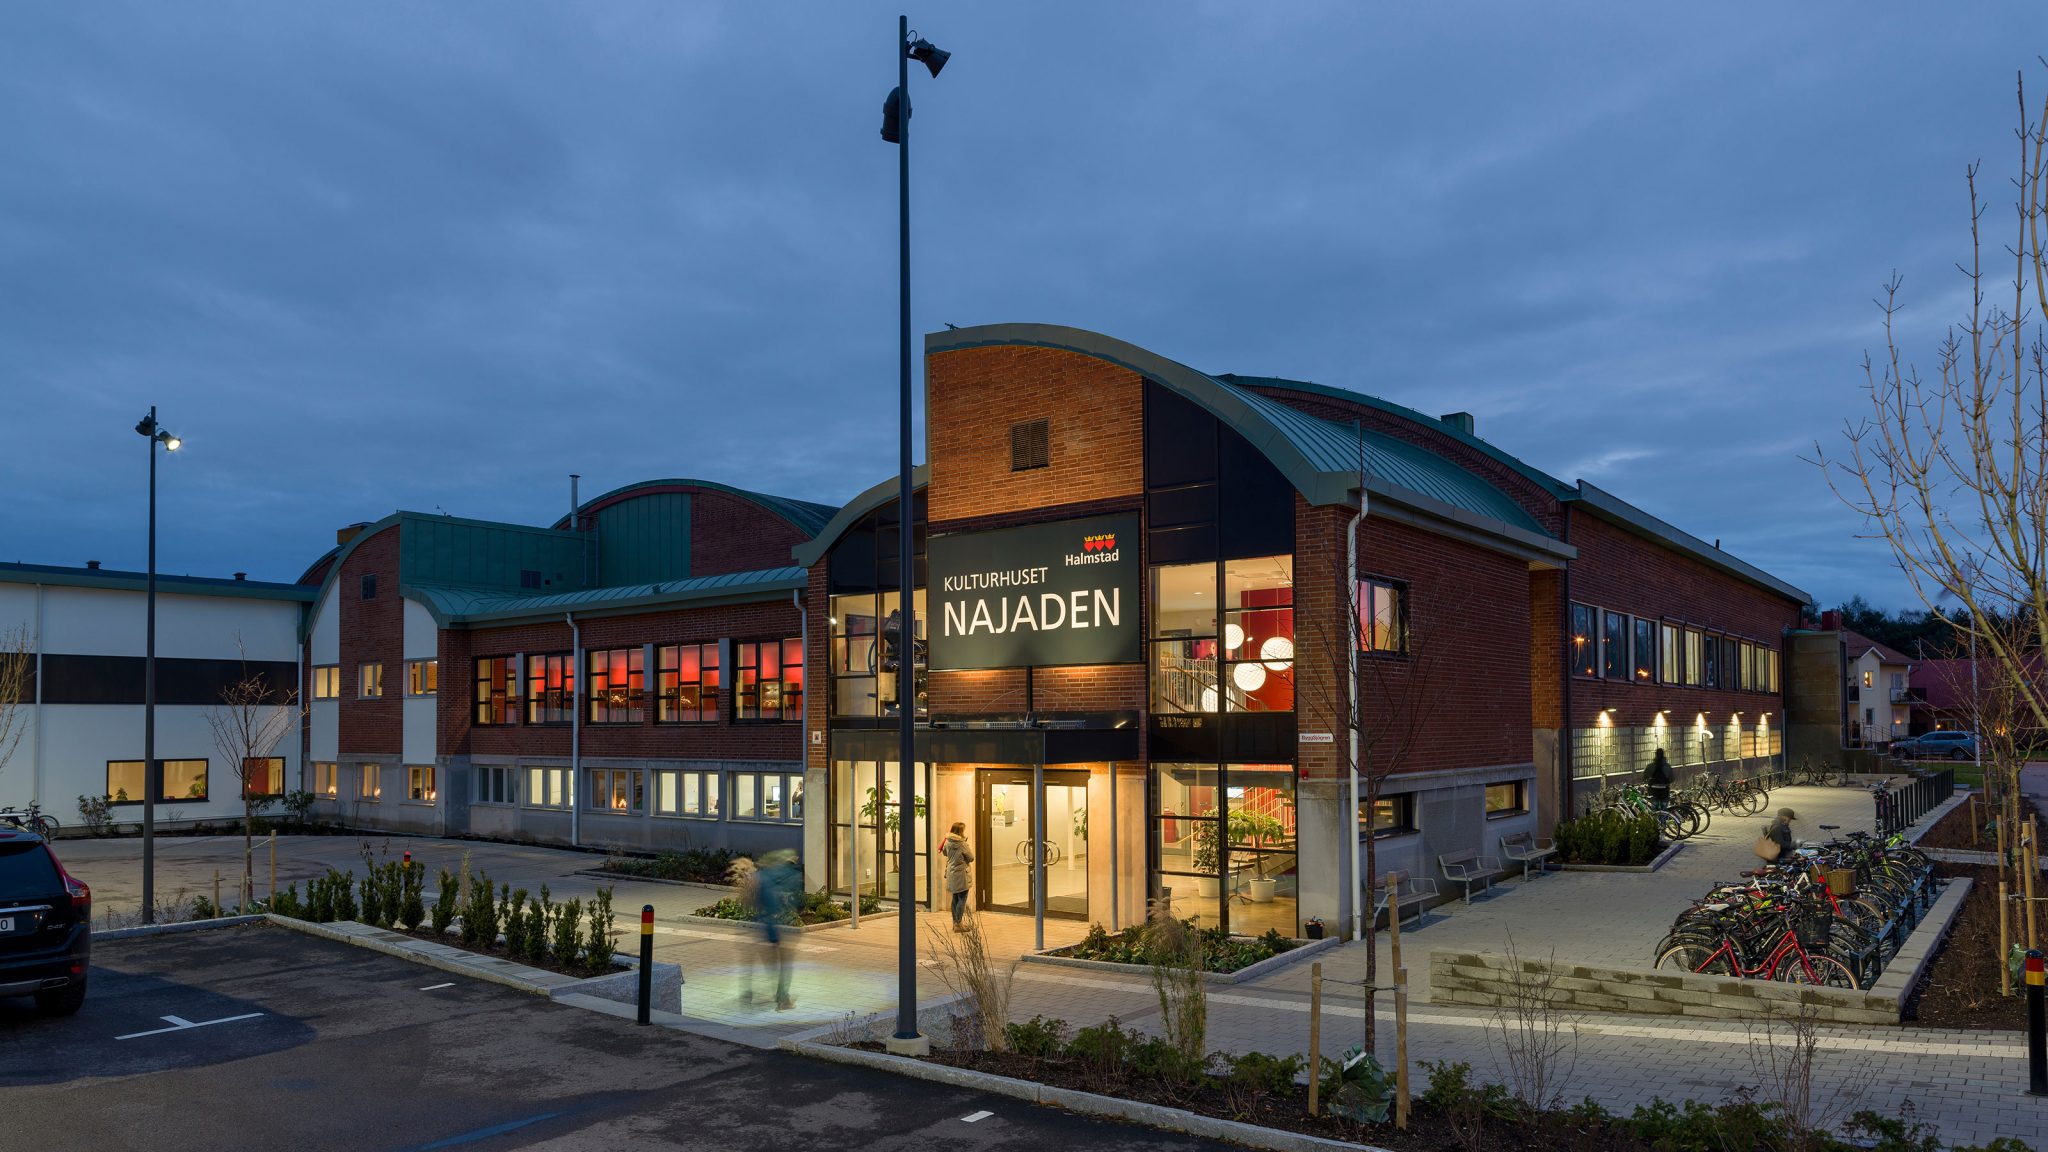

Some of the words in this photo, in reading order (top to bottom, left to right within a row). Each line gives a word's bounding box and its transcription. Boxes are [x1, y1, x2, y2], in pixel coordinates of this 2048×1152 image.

[1065, 549, 1120, 566] Halmstad
[944, 567, 1048, 592] KULTURHUSET
[944, 587, 1120, 637] NAJADEN
